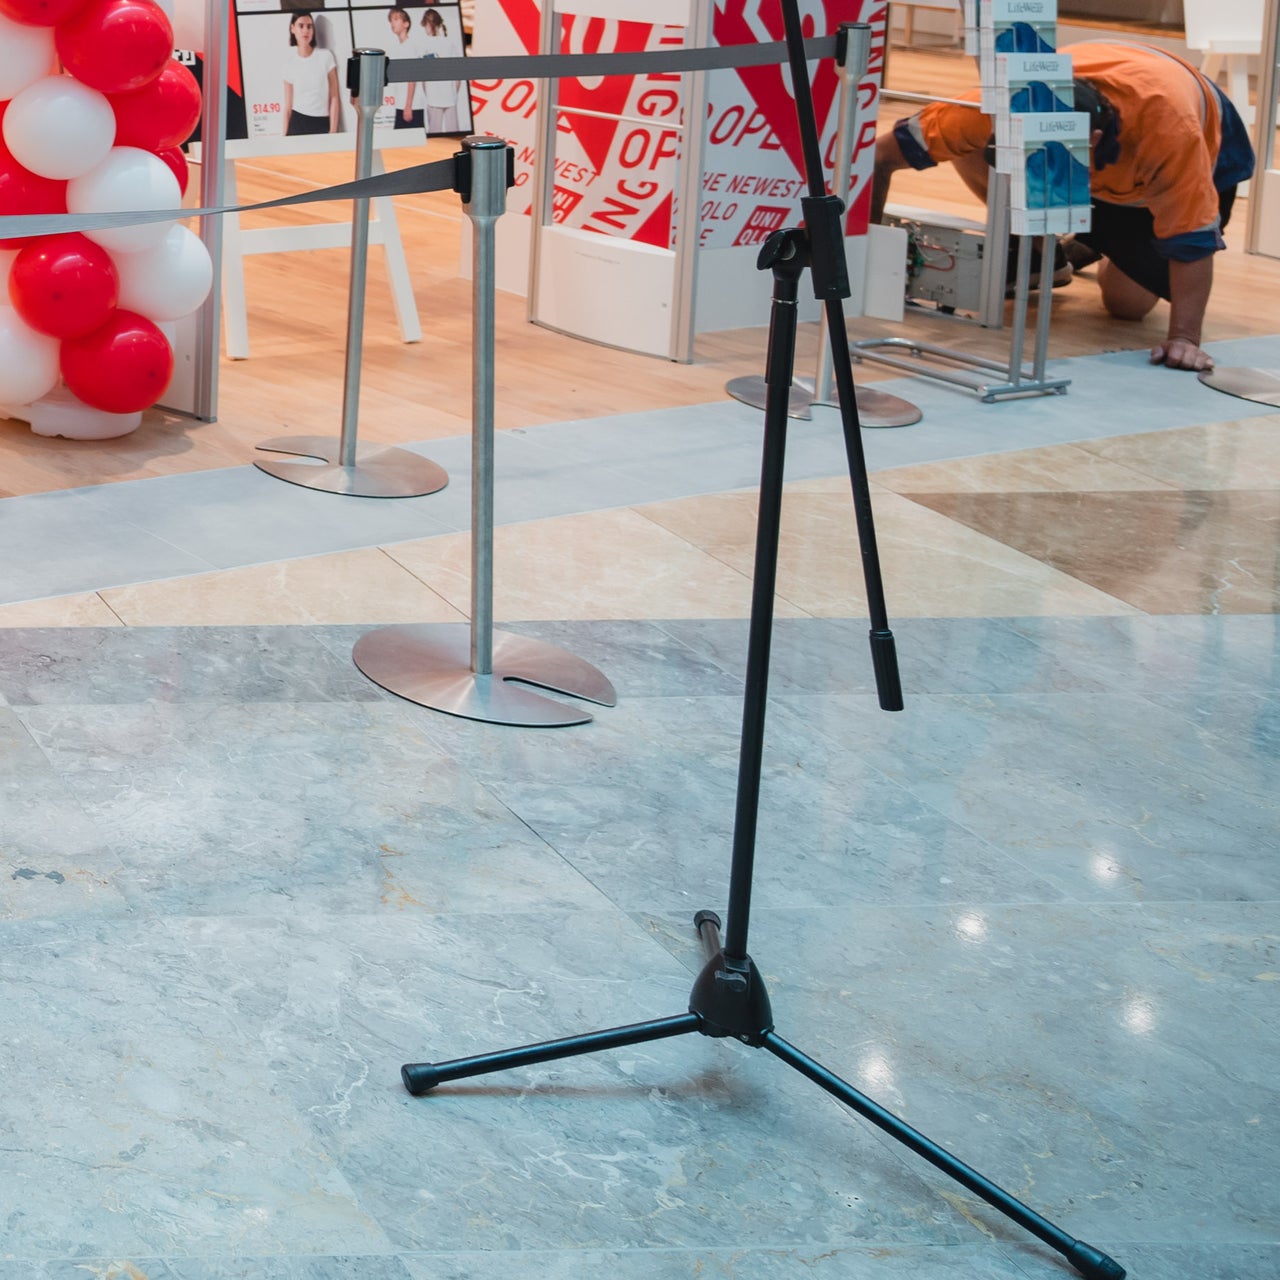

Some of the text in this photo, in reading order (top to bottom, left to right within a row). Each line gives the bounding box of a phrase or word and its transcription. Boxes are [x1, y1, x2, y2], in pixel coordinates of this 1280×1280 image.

[252, 102, 281, 114] $14.90
[726, 175, 807, 199] NEWEST
[750, 211, 782, 228] UNI
